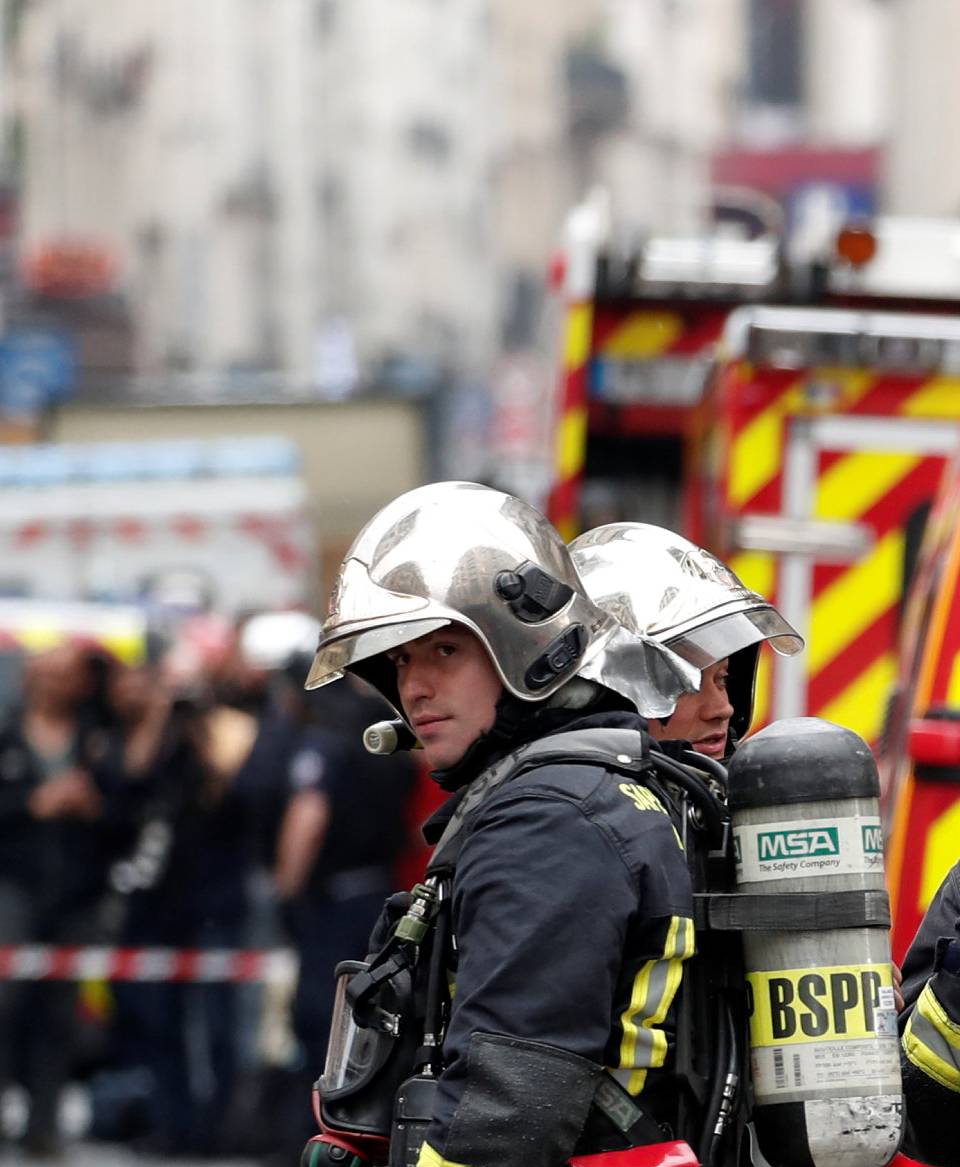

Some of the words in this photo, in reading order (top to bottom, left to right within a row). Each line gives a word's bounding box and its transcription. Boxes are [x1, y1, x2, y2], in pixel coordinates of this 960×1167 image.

[761, 831, 836, 858] MSA
[759, 864, 771, 872] The
[773, 862, 798, 872] Safety
[800, 859, 840, 869] Company
[768, 971, 881, 1039] BSPP
